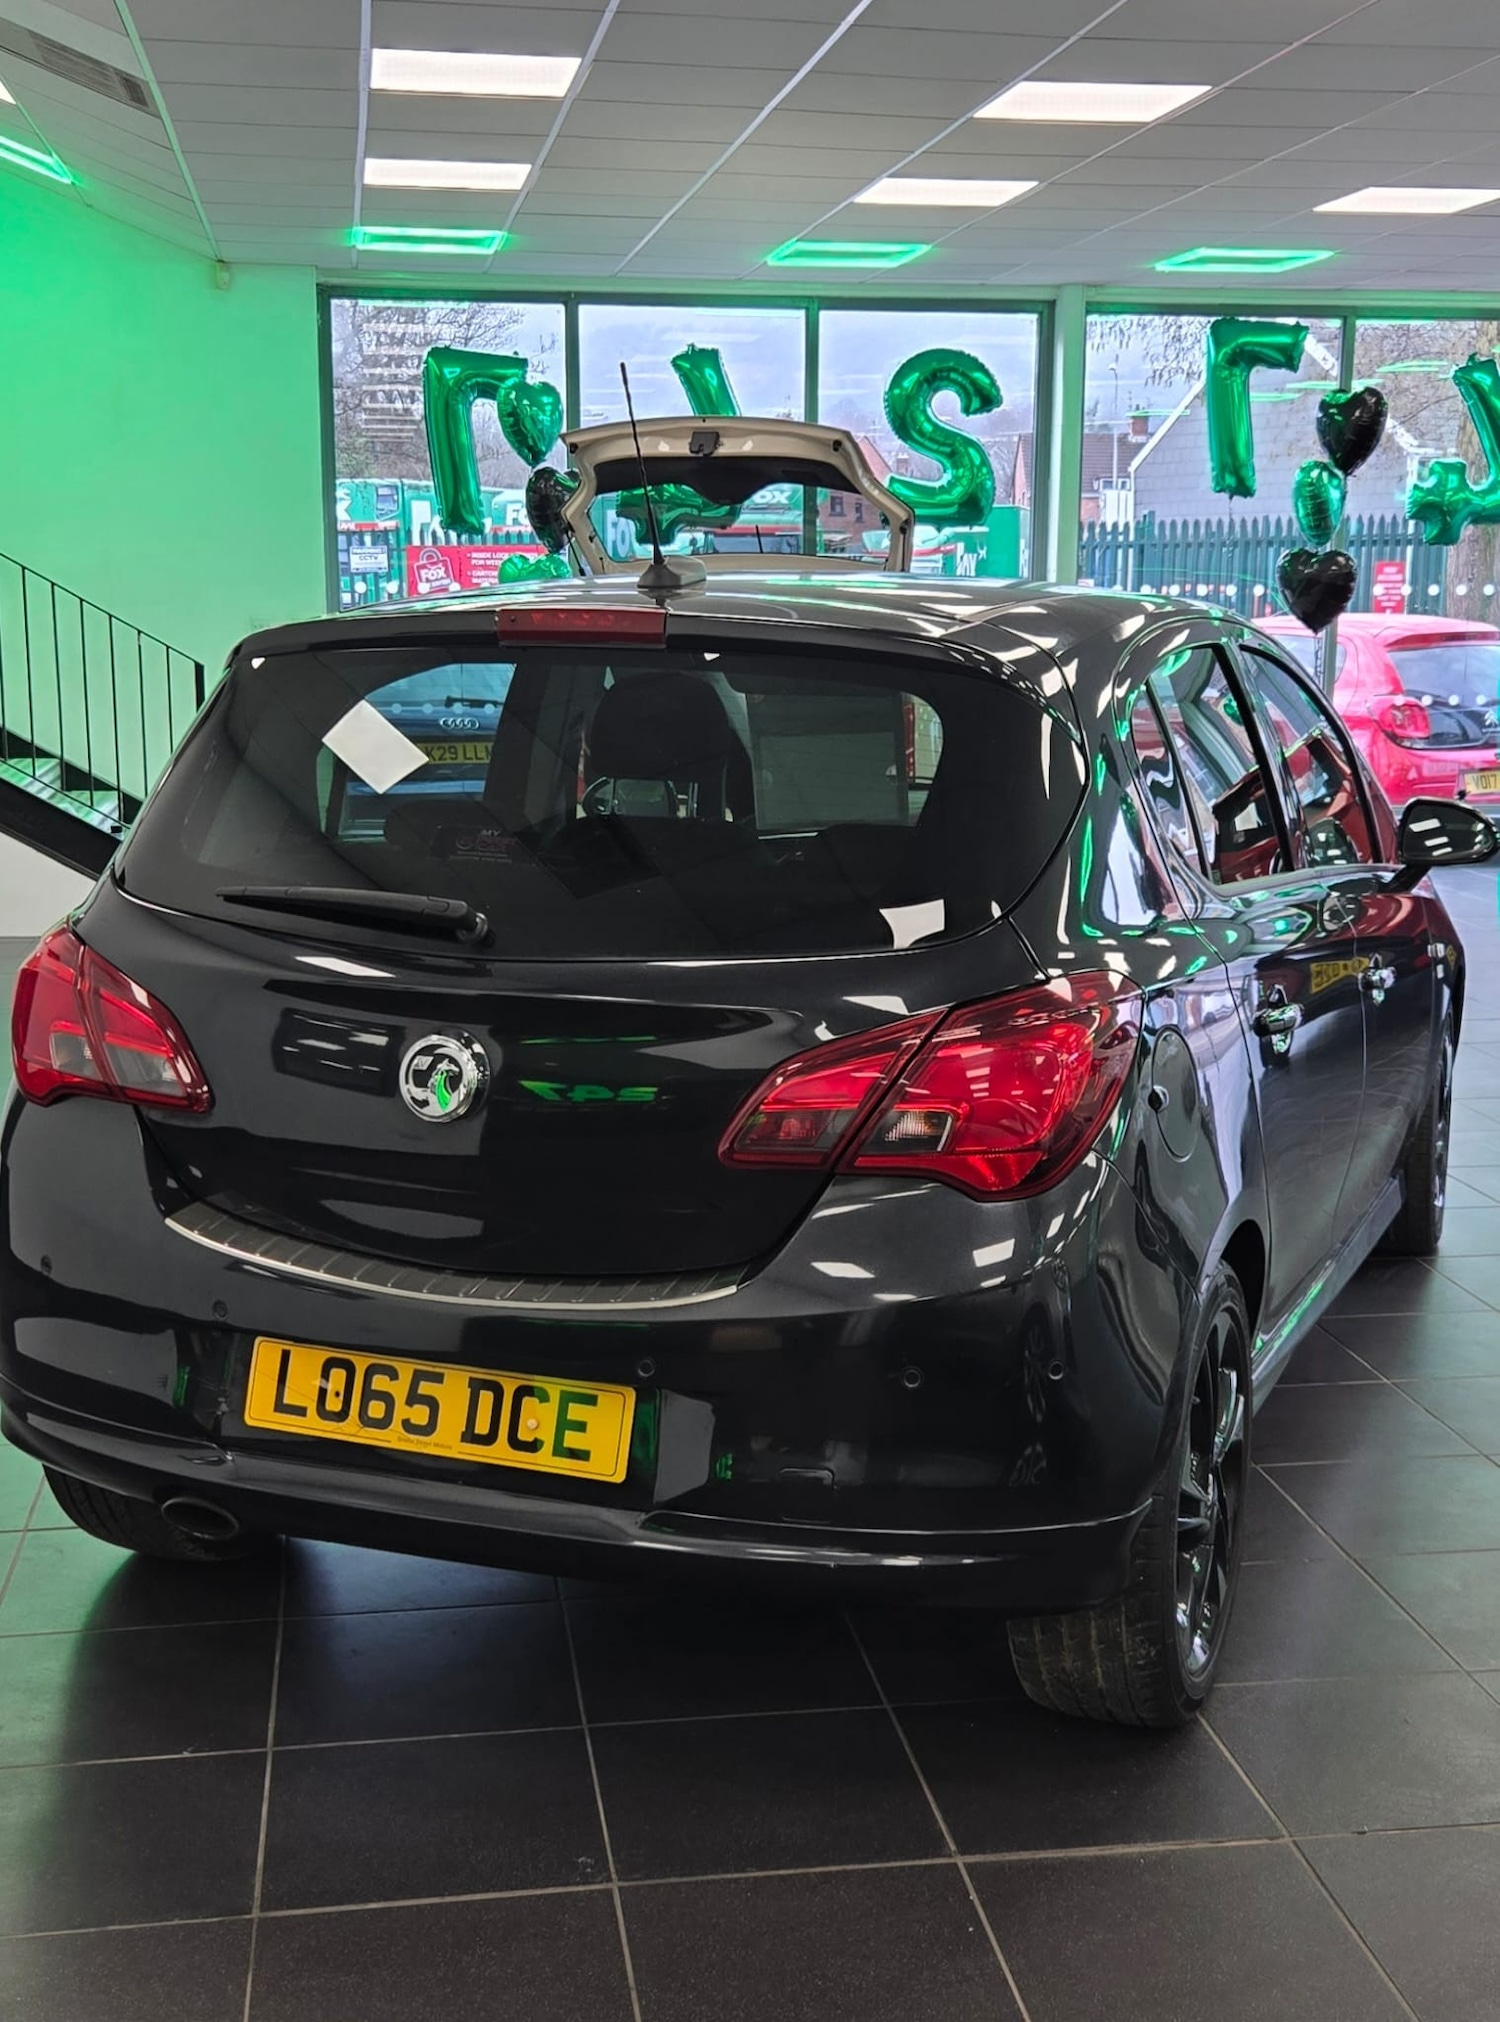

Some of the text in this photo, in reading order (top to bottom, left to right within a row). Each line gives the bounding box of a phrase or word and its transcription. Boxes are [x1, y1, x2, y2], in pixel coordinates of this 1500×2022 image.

[419, 563, 447, 583] FOX
[273, 1348, 600, 1463] LO65 DCE
